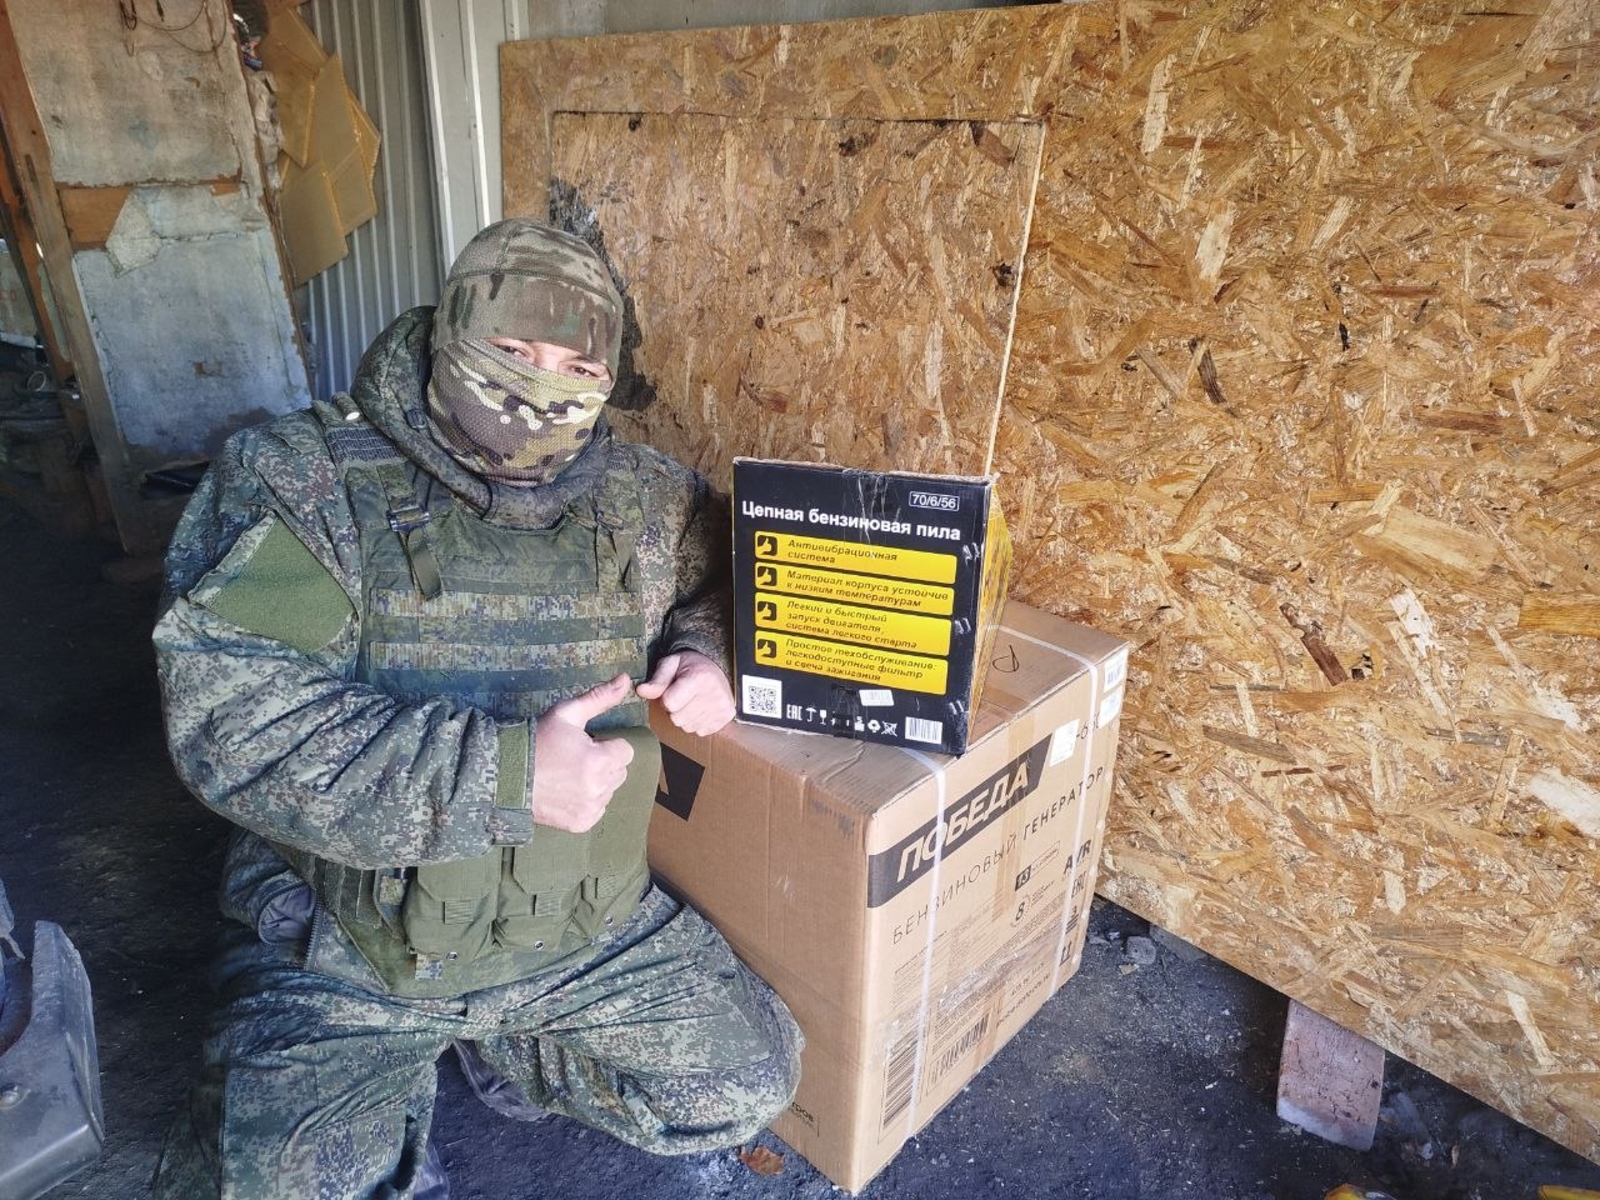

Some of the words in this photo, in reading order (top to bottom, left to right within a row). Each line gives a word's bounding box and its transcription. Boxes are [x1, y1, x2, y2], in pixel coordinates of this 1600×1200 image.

[912, 494, 956, 510] 70/6/56
[741, 500, 804, 522] Цепная
[809, 508, 911, 535] бензиновая
[917, 523, 961, 541] пила
[787, 551, 836, 563] система
[788, 539, 898, 561] Антивибрационная
[787, 569, 843, 586] Материал
[845, 580, 889, 592] корпуса
[795, 583, 833, 594] низким
[836, 588, 922, 607] температурам
[787, 613, 821, 624] запуск
[834, 607, 887, 623] быстрый
[786, 622, 830, 635] система
[832, 629, 872, 641] легкого
[875, 636, 918, 649] старта
[785, 638, 832, 653] Простое
[834, 647, 937, 671] техобслуживание:
[785, 649, 875, 671] легкодоступные
[877, 664, 924, 679] фильтр
[794, 661, 823, 671] свеча
[826, 666, 881, 681] зажигания
[896, 761, 1029, 883] ПОБЕДА
[893, 831, 1017, 945] БЕНЗИНОВЫЙ
[1023, 766, 1104, 840] ГЕНЕРАТОР
